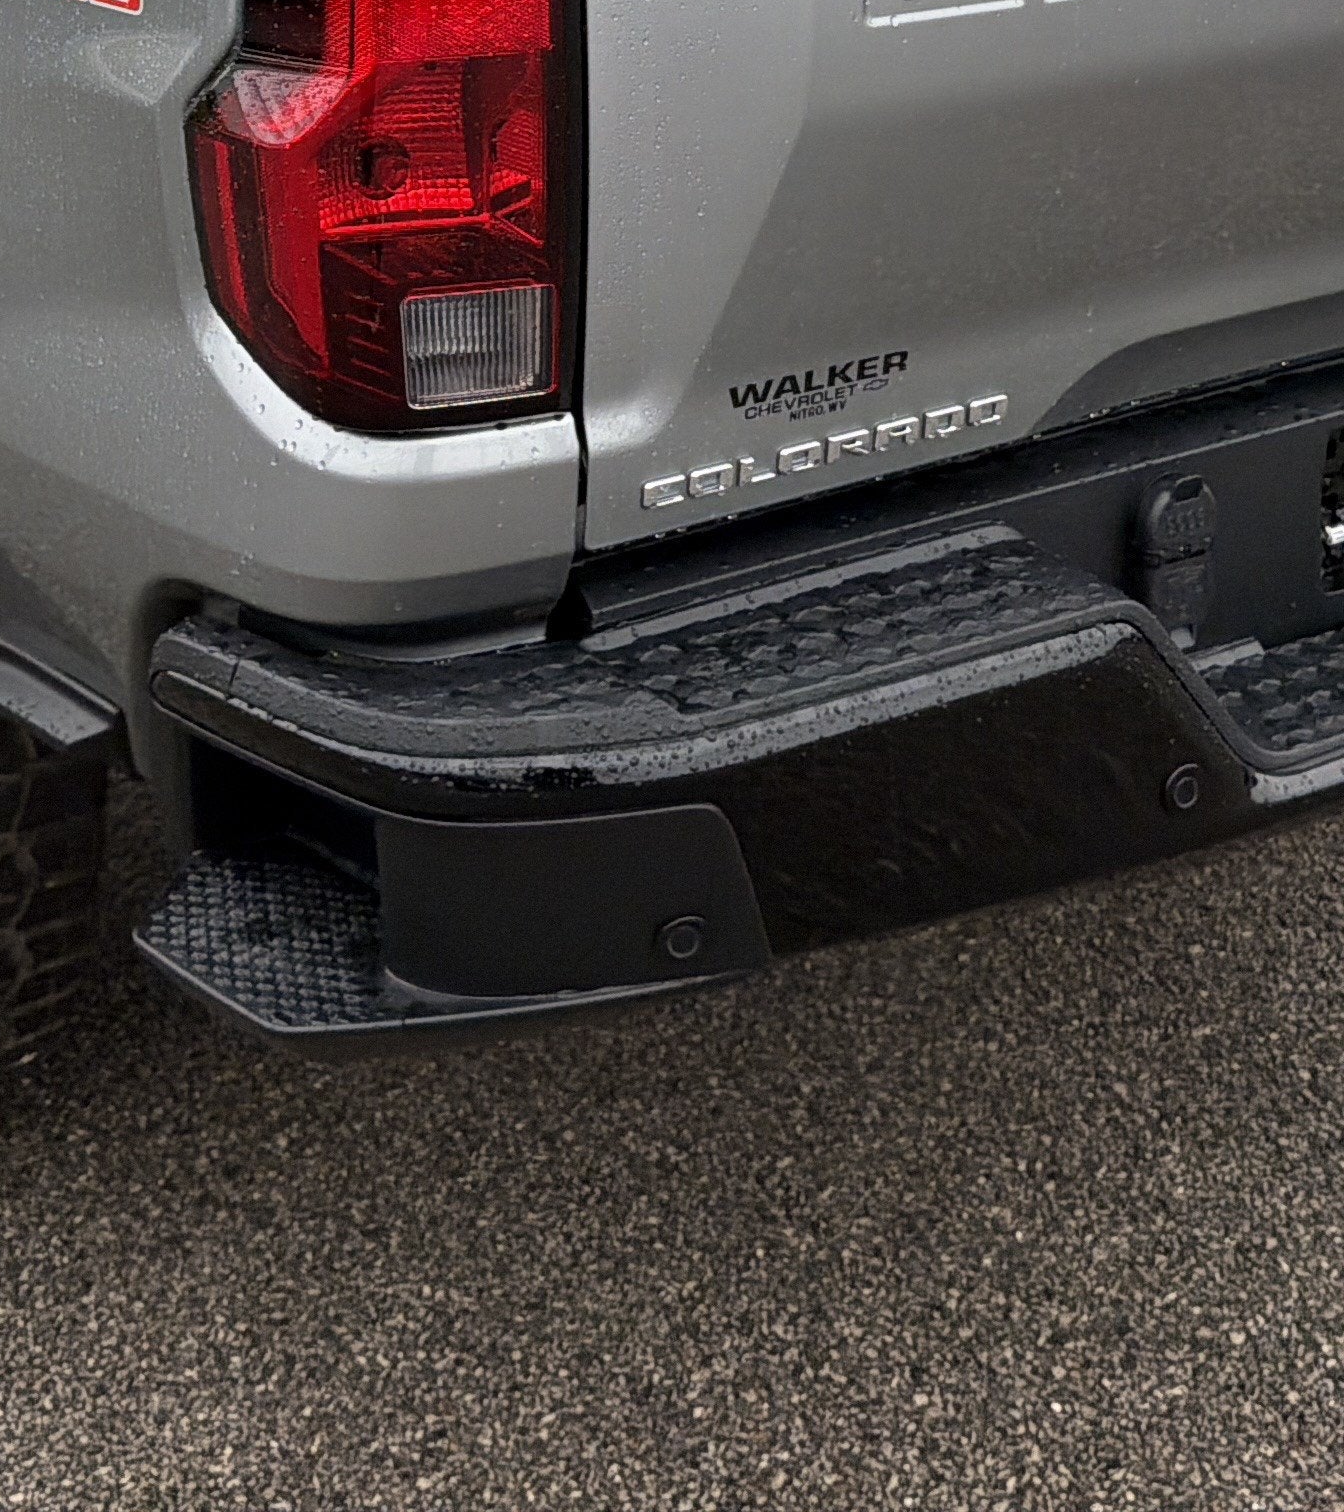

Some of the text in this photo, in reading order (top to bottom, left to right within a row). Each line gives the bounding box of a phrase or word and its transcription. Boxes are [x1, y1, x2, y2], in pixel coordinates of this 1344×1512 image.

[729, 351, 908, 408] WALKER
[745, 384, 858, 420] CHEVROLET
[641, 394, 1008, 509] COLORADO
